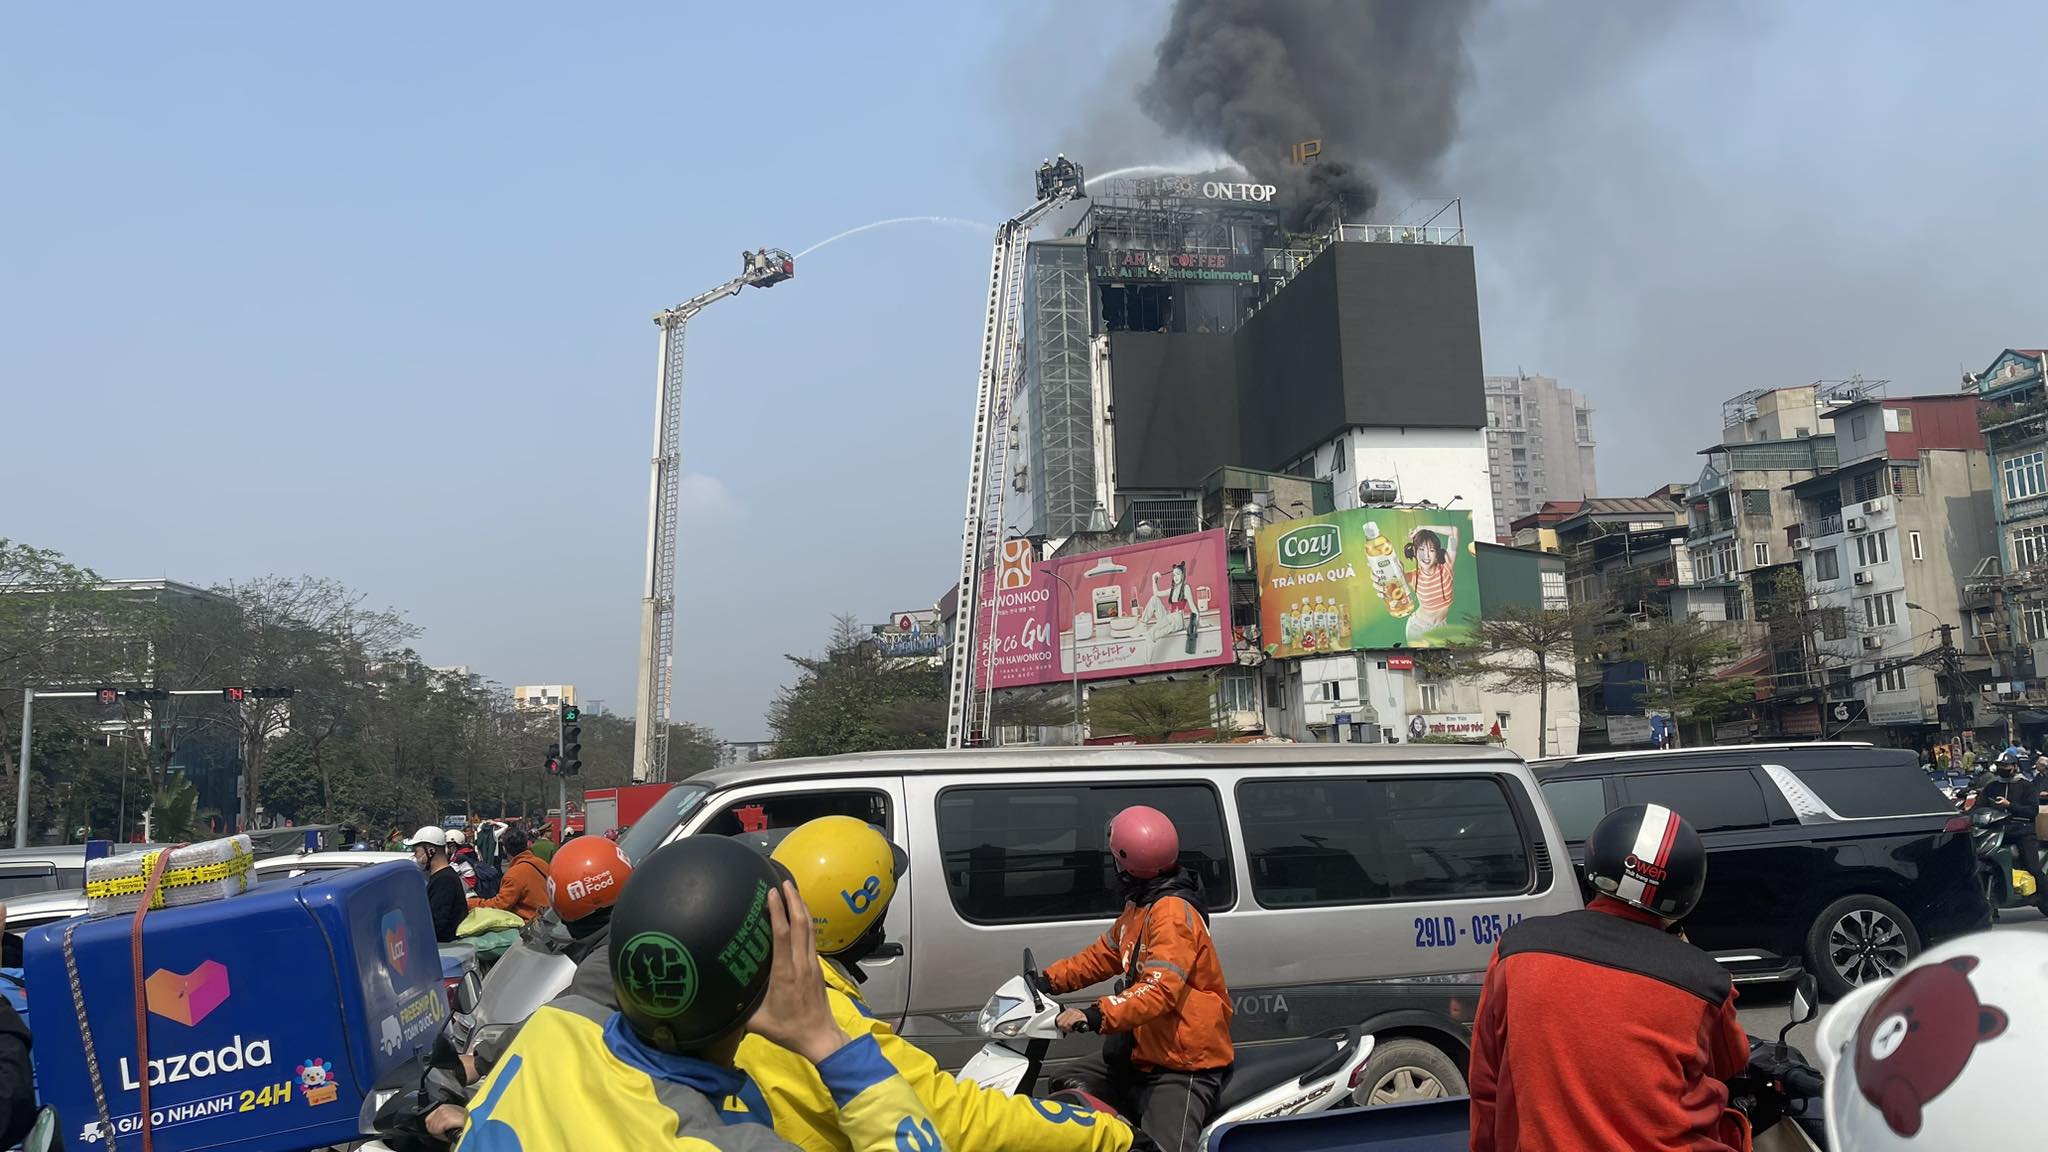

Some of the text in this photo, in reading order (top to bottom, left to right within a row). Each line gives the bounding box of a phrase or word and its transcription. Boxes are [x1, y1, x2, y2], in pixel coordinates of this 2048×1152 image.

[1202, 181, 1233, 200] ON
[1237, 183, 1277, 201] TOP
[1168, 254, 1225, 268] COFFEE
[1167, 267, 1252, 281] Entertainment
[1284, 533, 1332, 557] Cozy
[1272, 574, 1296, 589] TRÀ
[1297, 571, 1324, 585] HOA
[584, 870, 612, 885] Shopee
[585, 876, 614, 895] Food
[841, 876, 881, 914] be
[1414, 916, 1457, 948] 29LD
[1232, 994, 1289, 1016] YOTA
[119, 1034, 274, 1092] Lazada
[167, 1096, 234, 1124] NHANH
[238, 1080, 293, 1113] 24H
